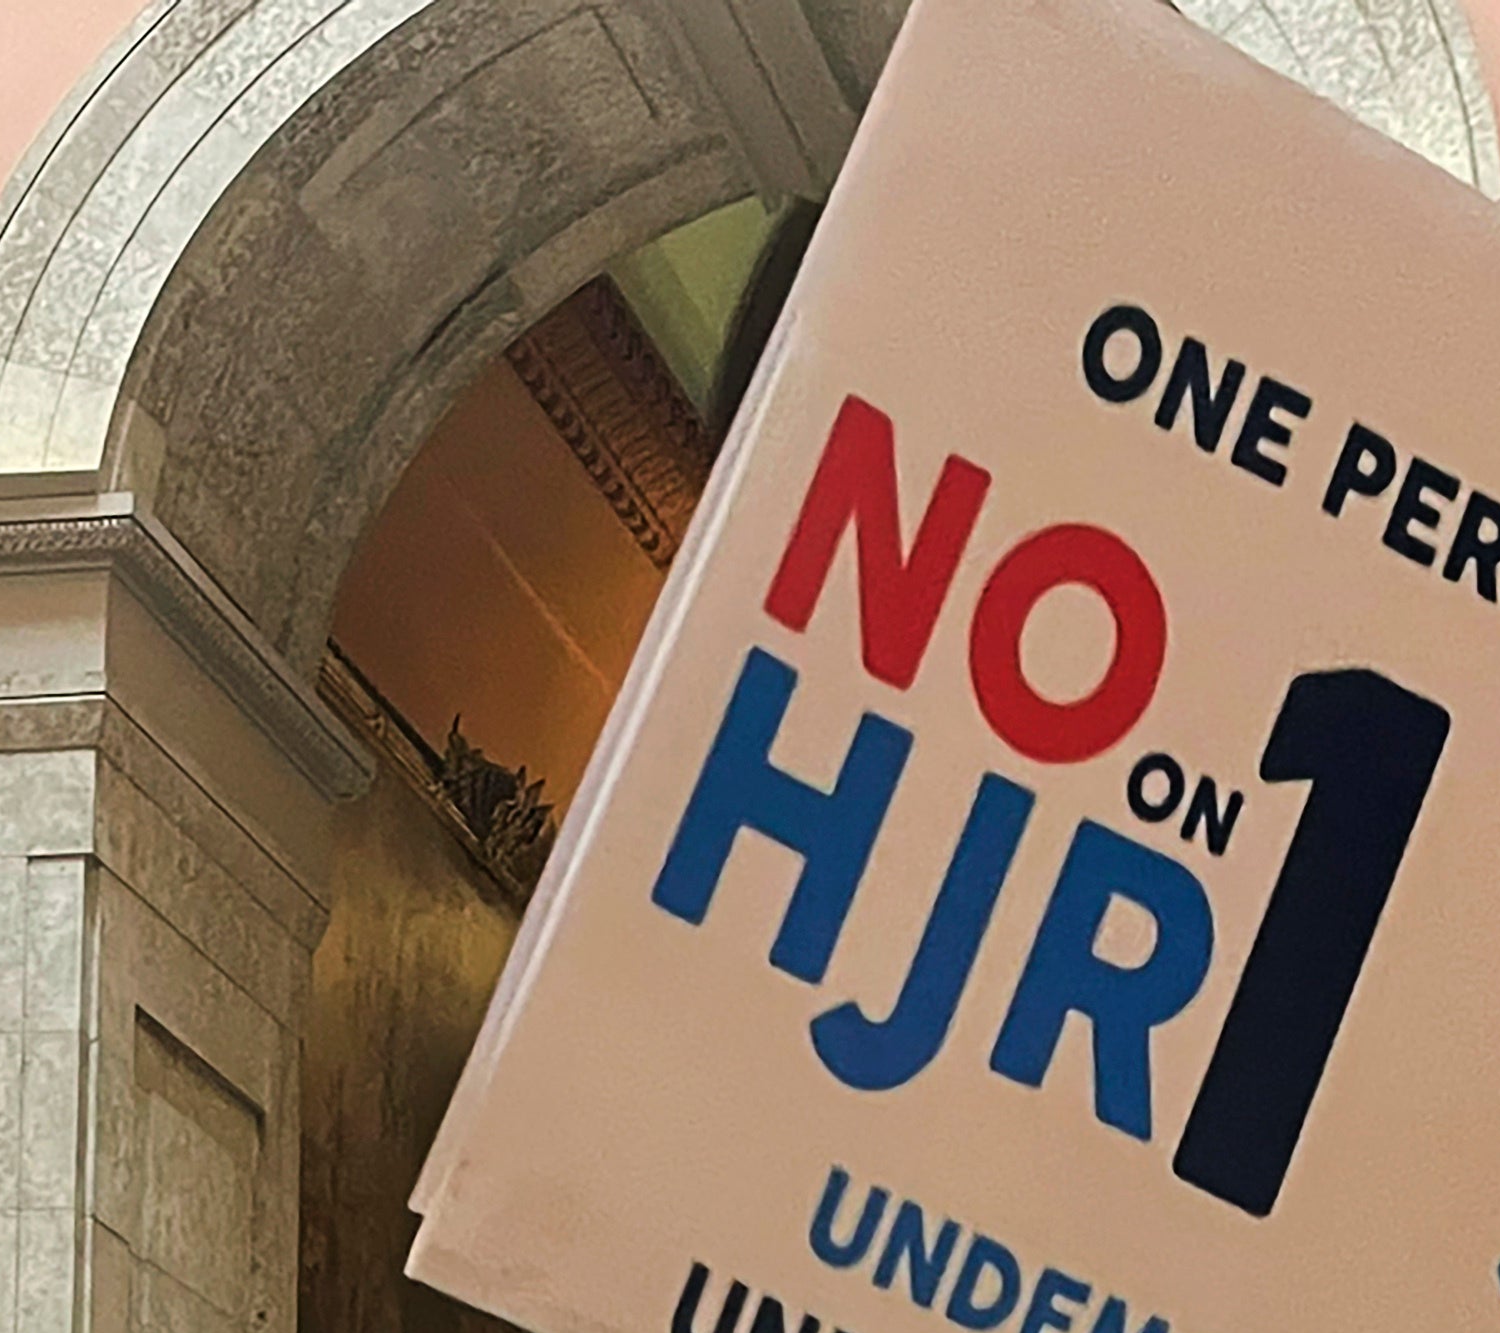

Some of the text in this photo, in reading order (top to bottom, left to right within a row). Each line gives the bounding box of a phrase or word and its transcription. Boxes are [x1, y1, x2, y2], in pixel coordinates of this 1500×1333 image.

[1080, 304, 1313, 487] ONE
[761, 394, 1245, 857] NO ON
